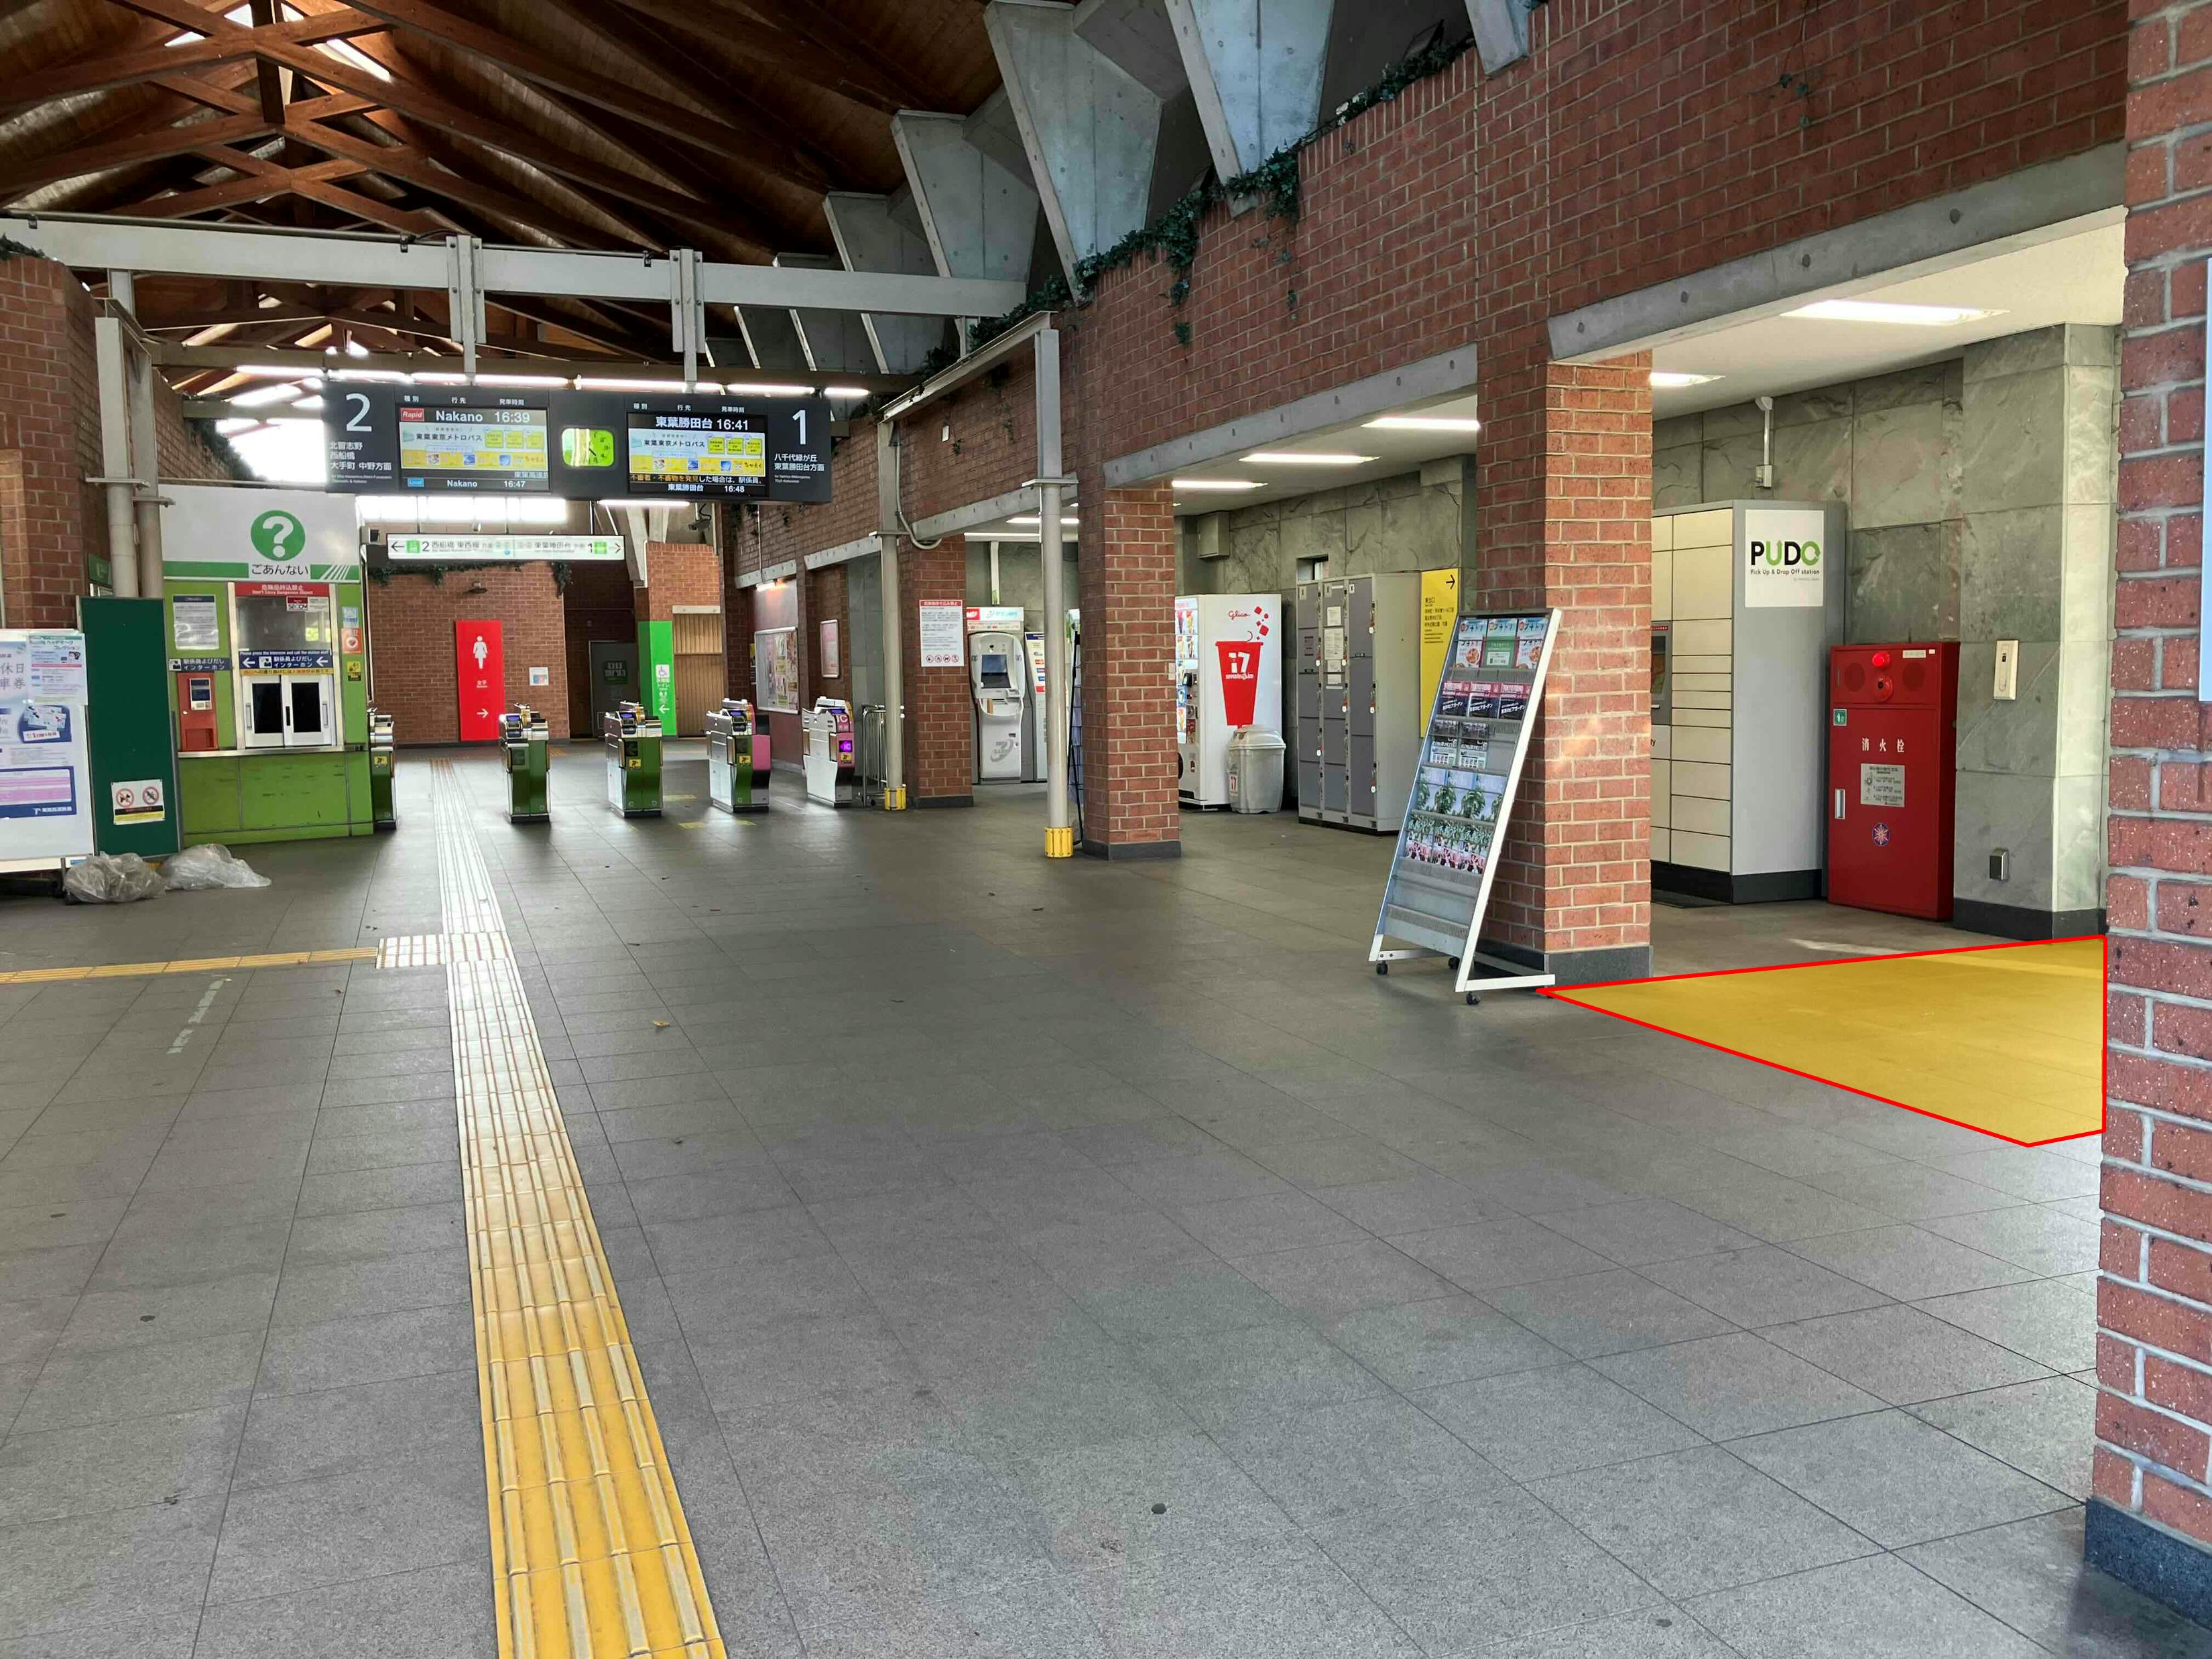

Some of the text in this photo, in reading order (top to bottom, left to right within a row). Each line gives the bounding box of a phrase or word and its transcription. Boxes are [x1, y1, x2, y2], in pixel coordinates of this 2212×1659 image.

[346, 393, 372, 432] 2
[436, 410, 483, 422] Nakano
[495, 412, 530, 423] 16:39
[656, 416, 749, 430] 東葉勝田台 16:41
[792, 410, 806, 444] 1
[330, 442, 363, 450] 北習志野
[330, 451, 355, 460] 西船橋
[774, 453, 817, 462] 八千代緑が丘
[330, 462, 391, 471] 大手町 中野方面
[774, 463, 824, 471] 東葉勝田台方面
[447, 480, 478, 488] Nakano
[668, 484, 745, 493] 東葉勝田台 16:48
[422, 541, 430, 552] 2
[1750, 540, 1821, 566] PUDO
[251, 564, 308, 575] ごあんない
[1228, 610, 1251, 620] Glico
[1861, 738, 1905, 753] 消火栓
